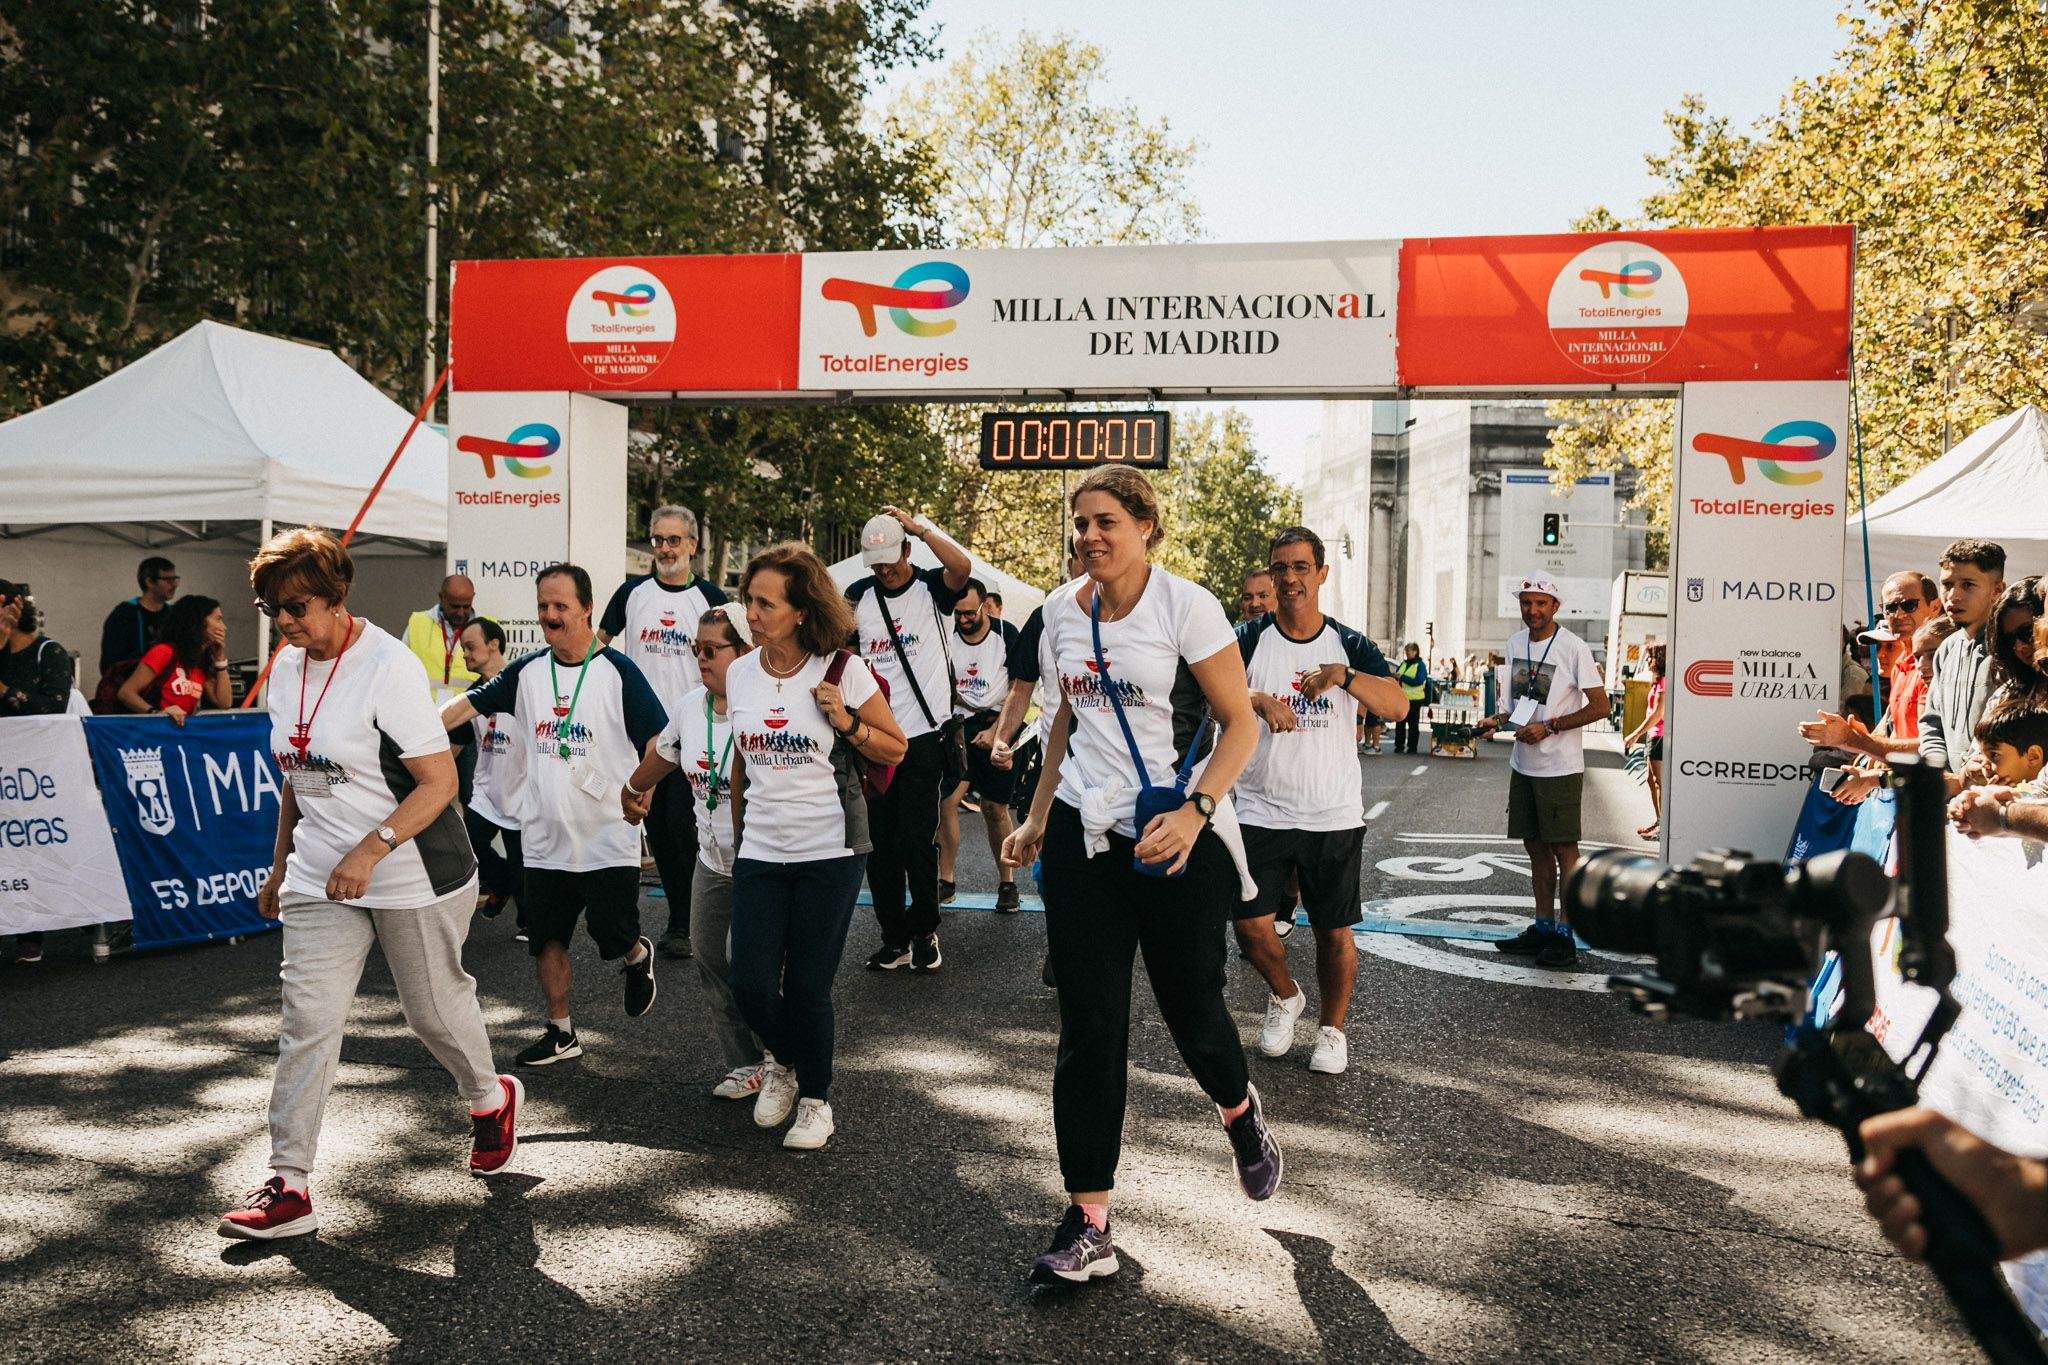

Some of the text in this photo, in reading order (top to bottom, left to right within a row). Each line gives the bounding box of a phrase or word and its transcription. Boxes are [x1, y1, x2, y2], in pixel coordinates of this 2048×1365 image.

[991, 293, 1386, 322] MILLA INTERNACIONaL
[1578, 306, 1662, 319] TotalEnergies
[591, 324, 656, 335] TotalEnergies
[1598, 331, 1637, 341] MILLA
[606, 344, 637, 354] MILLA
[1088, 330, 1280, 356] DE MADRID
[819, 353, 969, 377] TotalEnergies
[1582, 353, 1651, 364] DE MADRID
[594, 365, 648, 374] DE MADRID
[992, 419, 1156, 461] 00:00:00
[455, 490, 561, 508] TotalEnergies
[1690, 499, 1835, 520] TotalEnergies
[1722, 581, 1835, 602] MADRID
[1761, 649, 1802, 658] balance
[1741, 661, 1818, 679] MILLA
[1740, 682, 1829, 700] URBANA
[749, 753, 814, 766] Milla Urbana
[150, 878, 190, 911] ES
